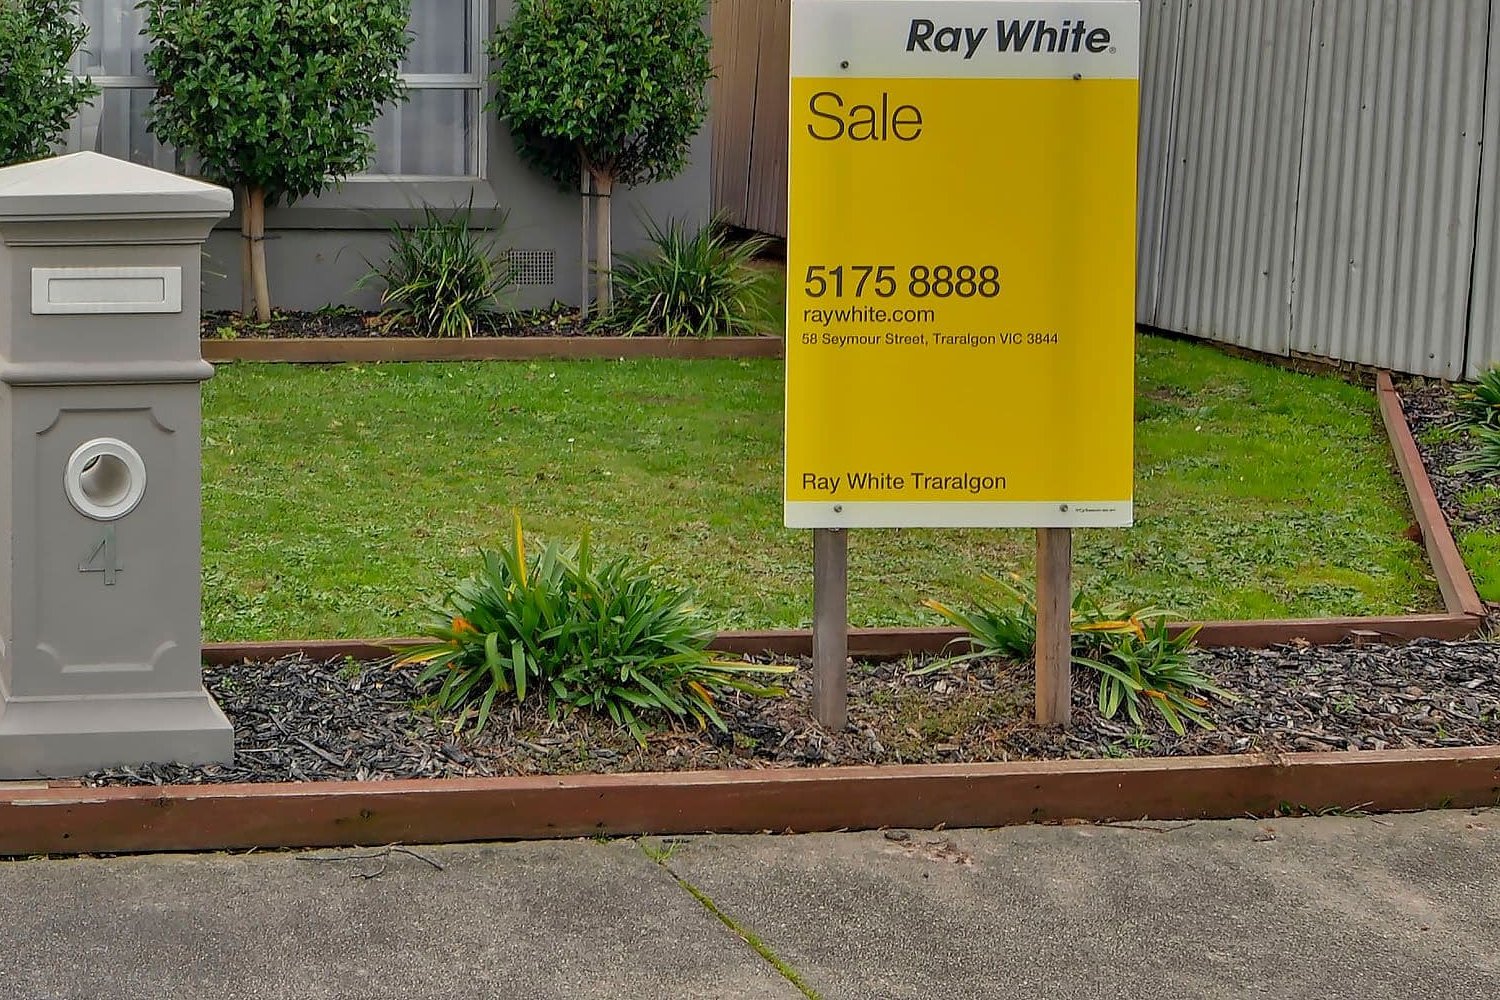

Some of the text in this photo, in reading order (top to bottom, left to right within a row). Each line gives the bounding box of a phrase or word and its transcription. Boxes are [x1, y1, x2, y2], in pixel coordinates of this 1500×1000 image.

[905, 18, 1111, 60] Ray White
[807, 91, 923, 142] Sale
[804, 264, 1001, 299] 5175 8888
[803, 305, 935, 328] raywhite.com
[802, 332, 1059, 348] 58 Seymour Street, Traralgon VIC 3844
[802, 471, 1007, 495] Ray White Traralgon
[77, 524, 124, 587] 4
